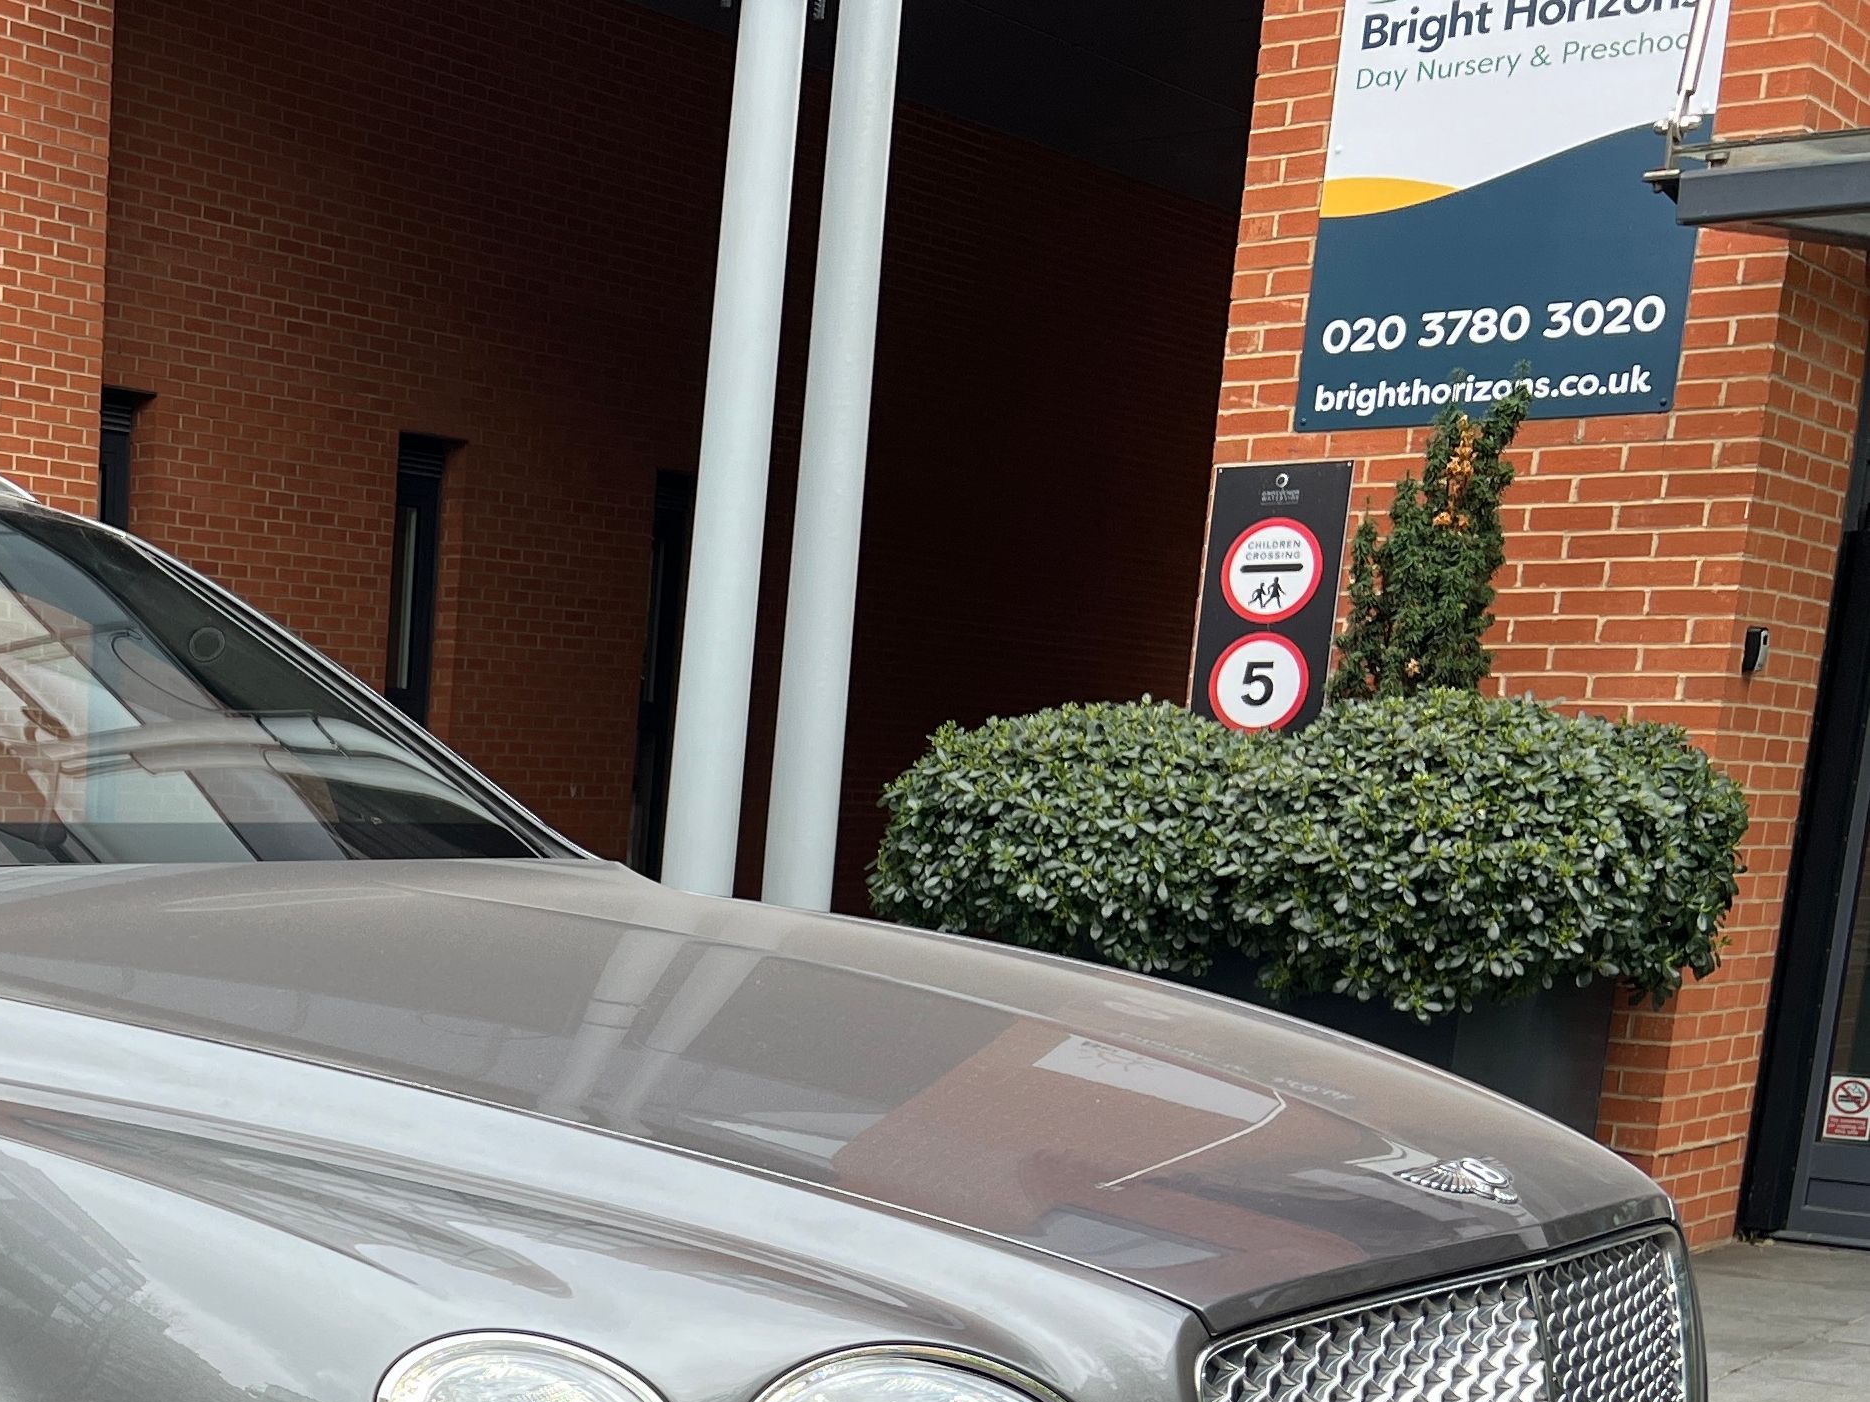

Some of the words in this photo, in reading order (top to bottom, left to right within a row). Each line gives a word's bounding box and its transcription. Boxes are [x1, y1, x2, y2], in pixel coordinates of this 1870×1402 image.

[1361, 0, 1493, 53] Bright
[1356, 67, 1408, 92] Day
[1417, 53, 1521, 82] Nursery
[1530, 44, 1552, 67] &
[1562, 32, 1690, 64] Preschoo
[1322, 315, 1407, 355] 020
[1417, 304, 1530, 347] 3780
[1542, 295, 1666, 339] 3020
[1245, 551, 1301, 560] CROSSING
[1247, 540, 1301, 550] CHILDREN
[1241, 661, 1274, 706] 5
